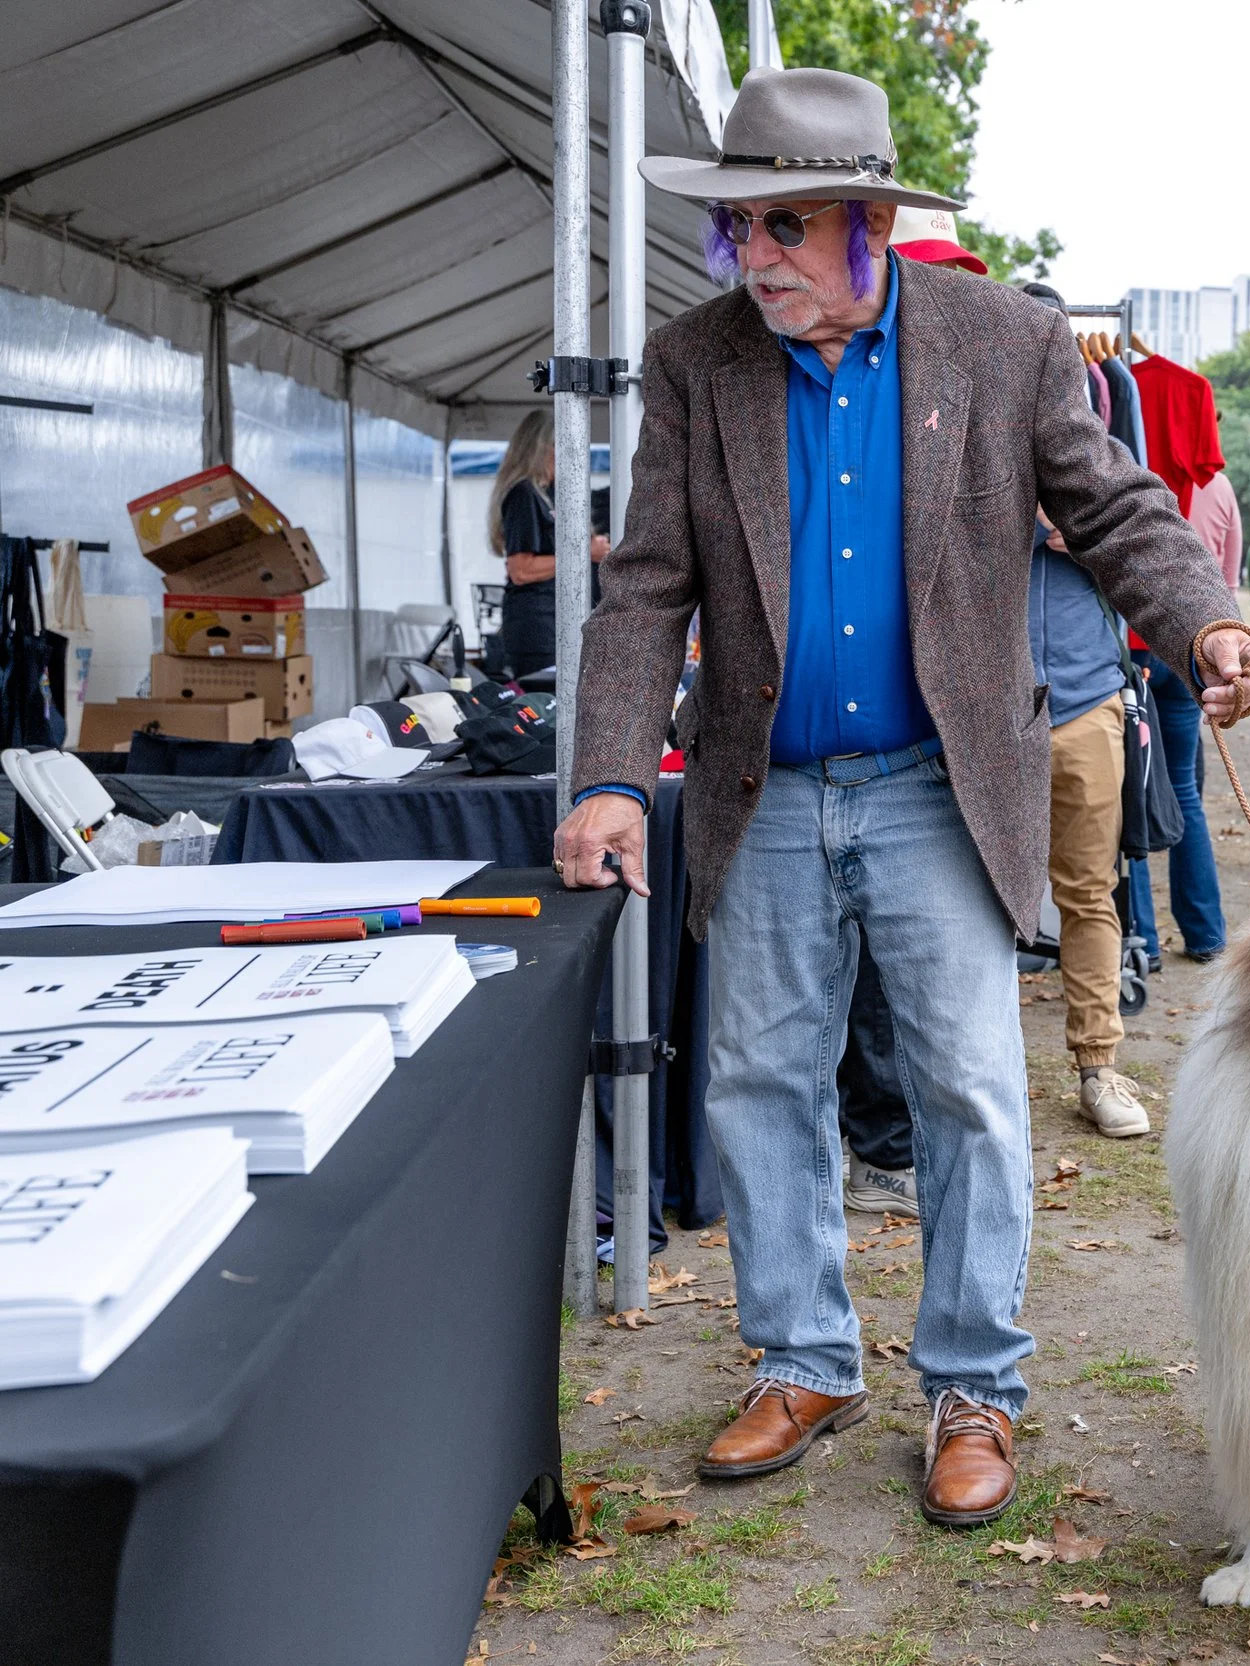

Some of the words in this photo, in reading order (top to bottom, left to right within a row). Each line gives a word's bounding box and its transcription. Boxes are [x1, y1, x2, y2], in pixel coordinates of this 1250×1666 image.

[78, 959, 203, 1011] DEATH
[296, 951, 382, 987] LIFE
[176, 1034, 294, 1084] LIFE
[865, 1170, 906, 1196] HOKA
